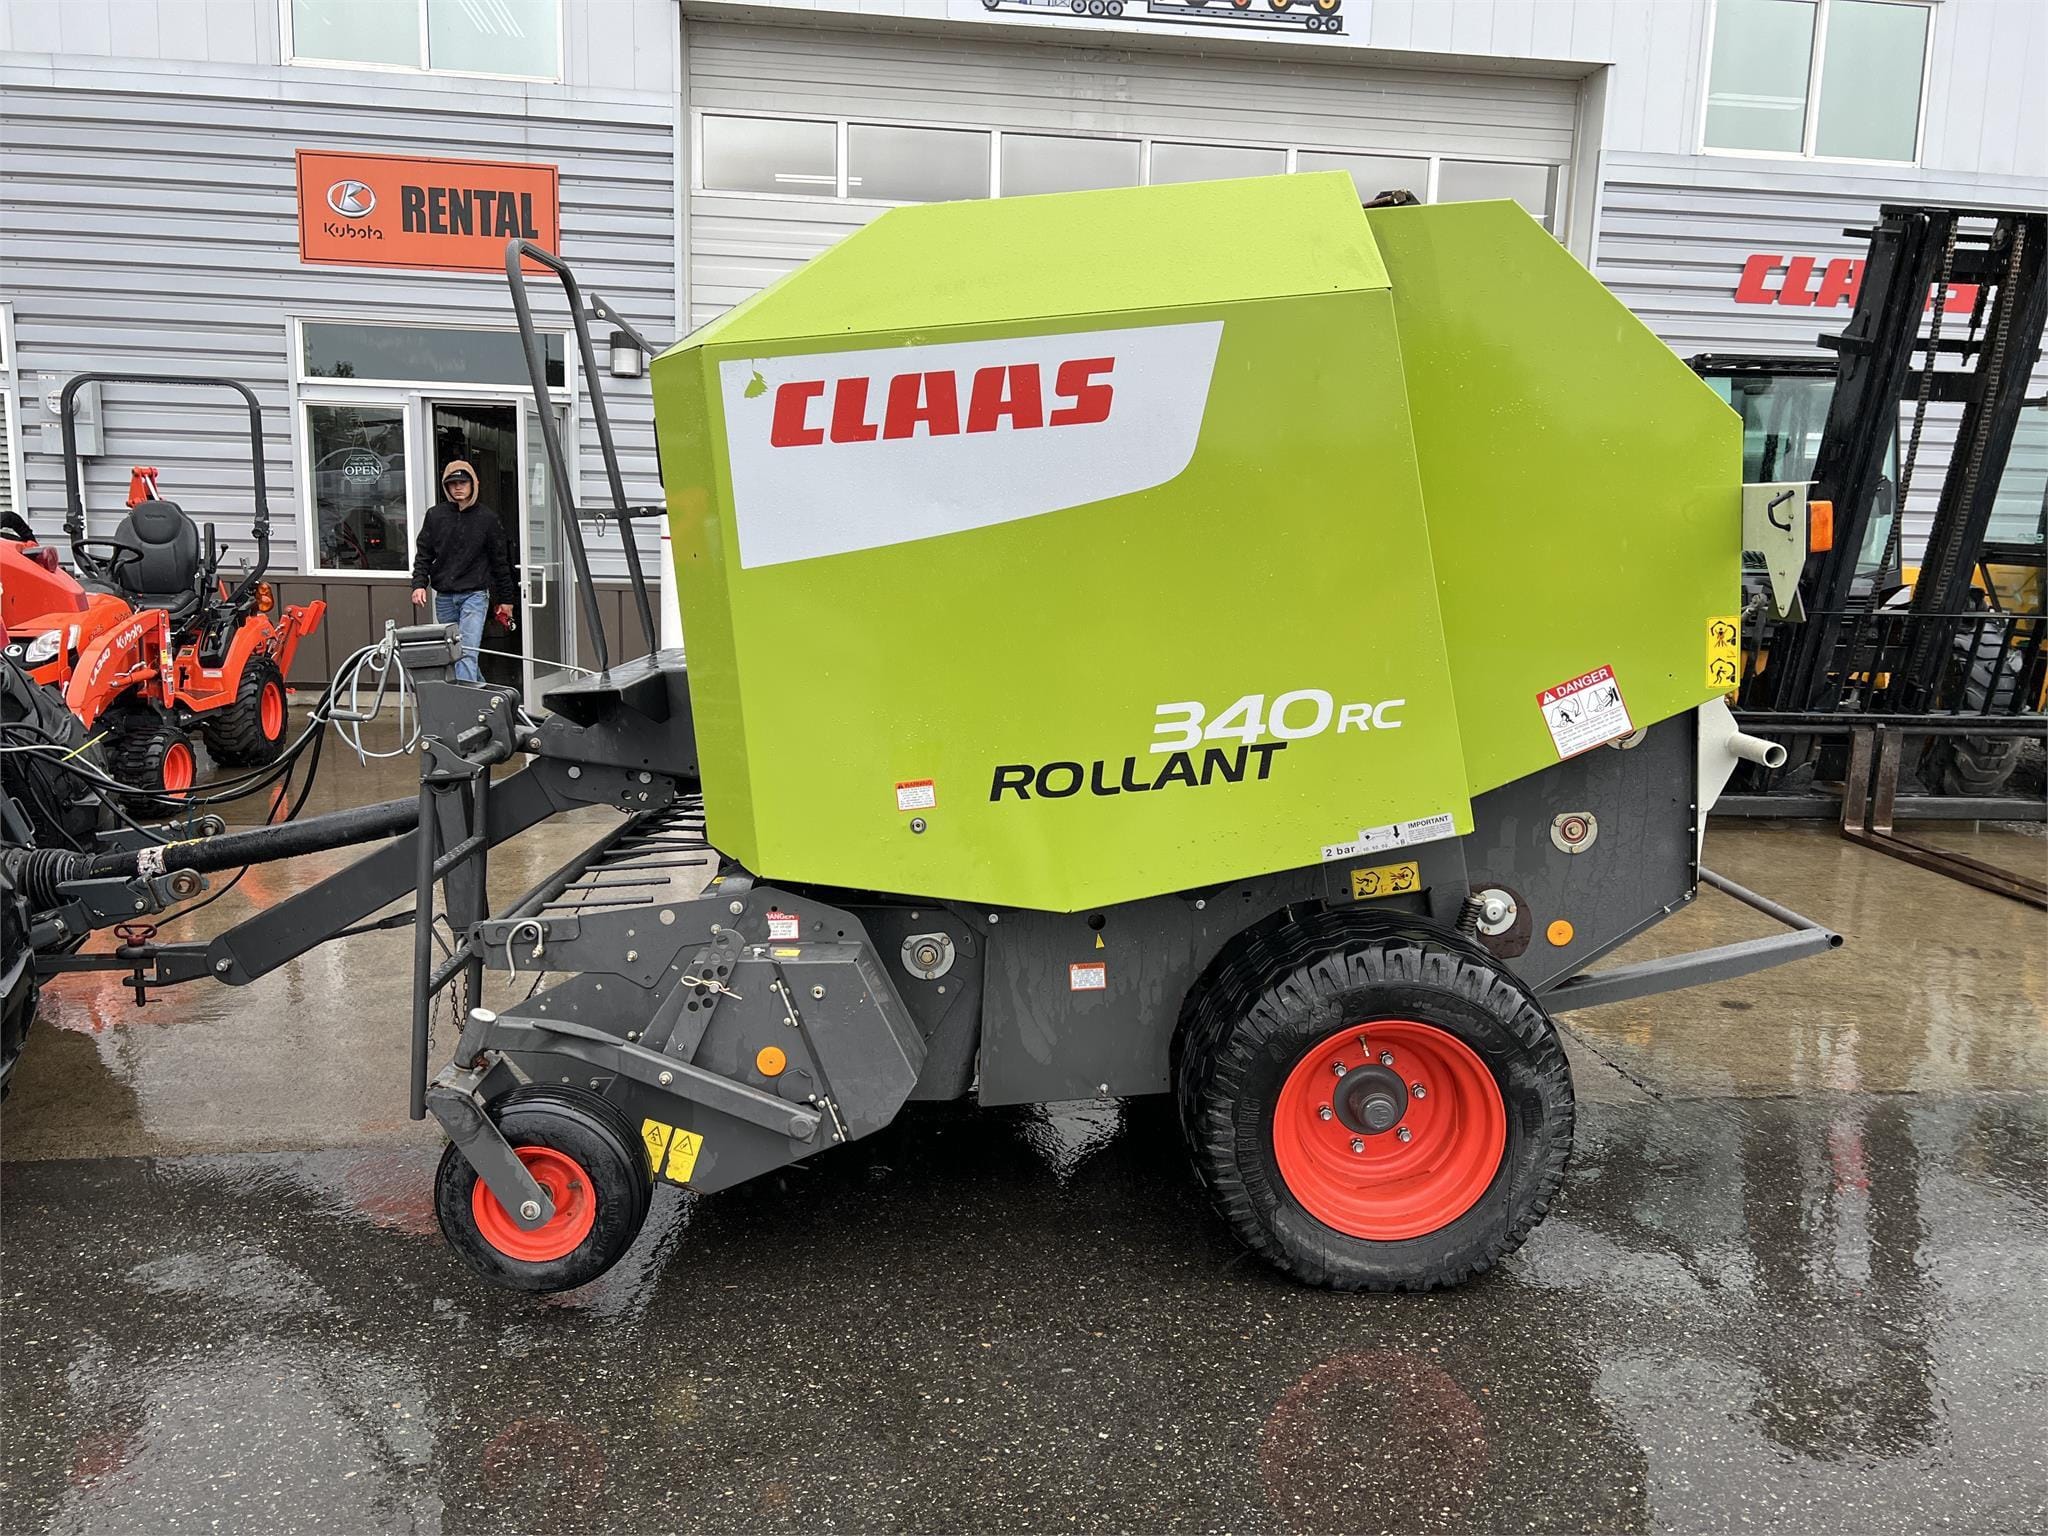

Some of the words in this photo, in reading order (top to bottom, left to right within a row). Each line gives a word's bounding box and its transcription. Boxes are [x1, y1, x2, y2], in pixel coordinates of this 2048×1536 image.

[401, 185, 538, 239] RENTAL
[324, 222, 383, 241] Kubota
[1735, 254, 1980, 314] CLA
[770, 357, 1115, 448] CLAAS
[345, 466, 380, 475] OPEN
[115, 623, 144, 649] Kubota
[1556, 668, 1609, 697] DANGER
[1149, 689, 1333, 753] 340
[1337, 699, 1406, 734] RC
[989, 741, 1288, 802] ROLLANT
[1407, 815, 1449, 829] IMPORTANT
[1326, 848, 1333, 857] 2
[1336, 846, 1356, 855] bar
